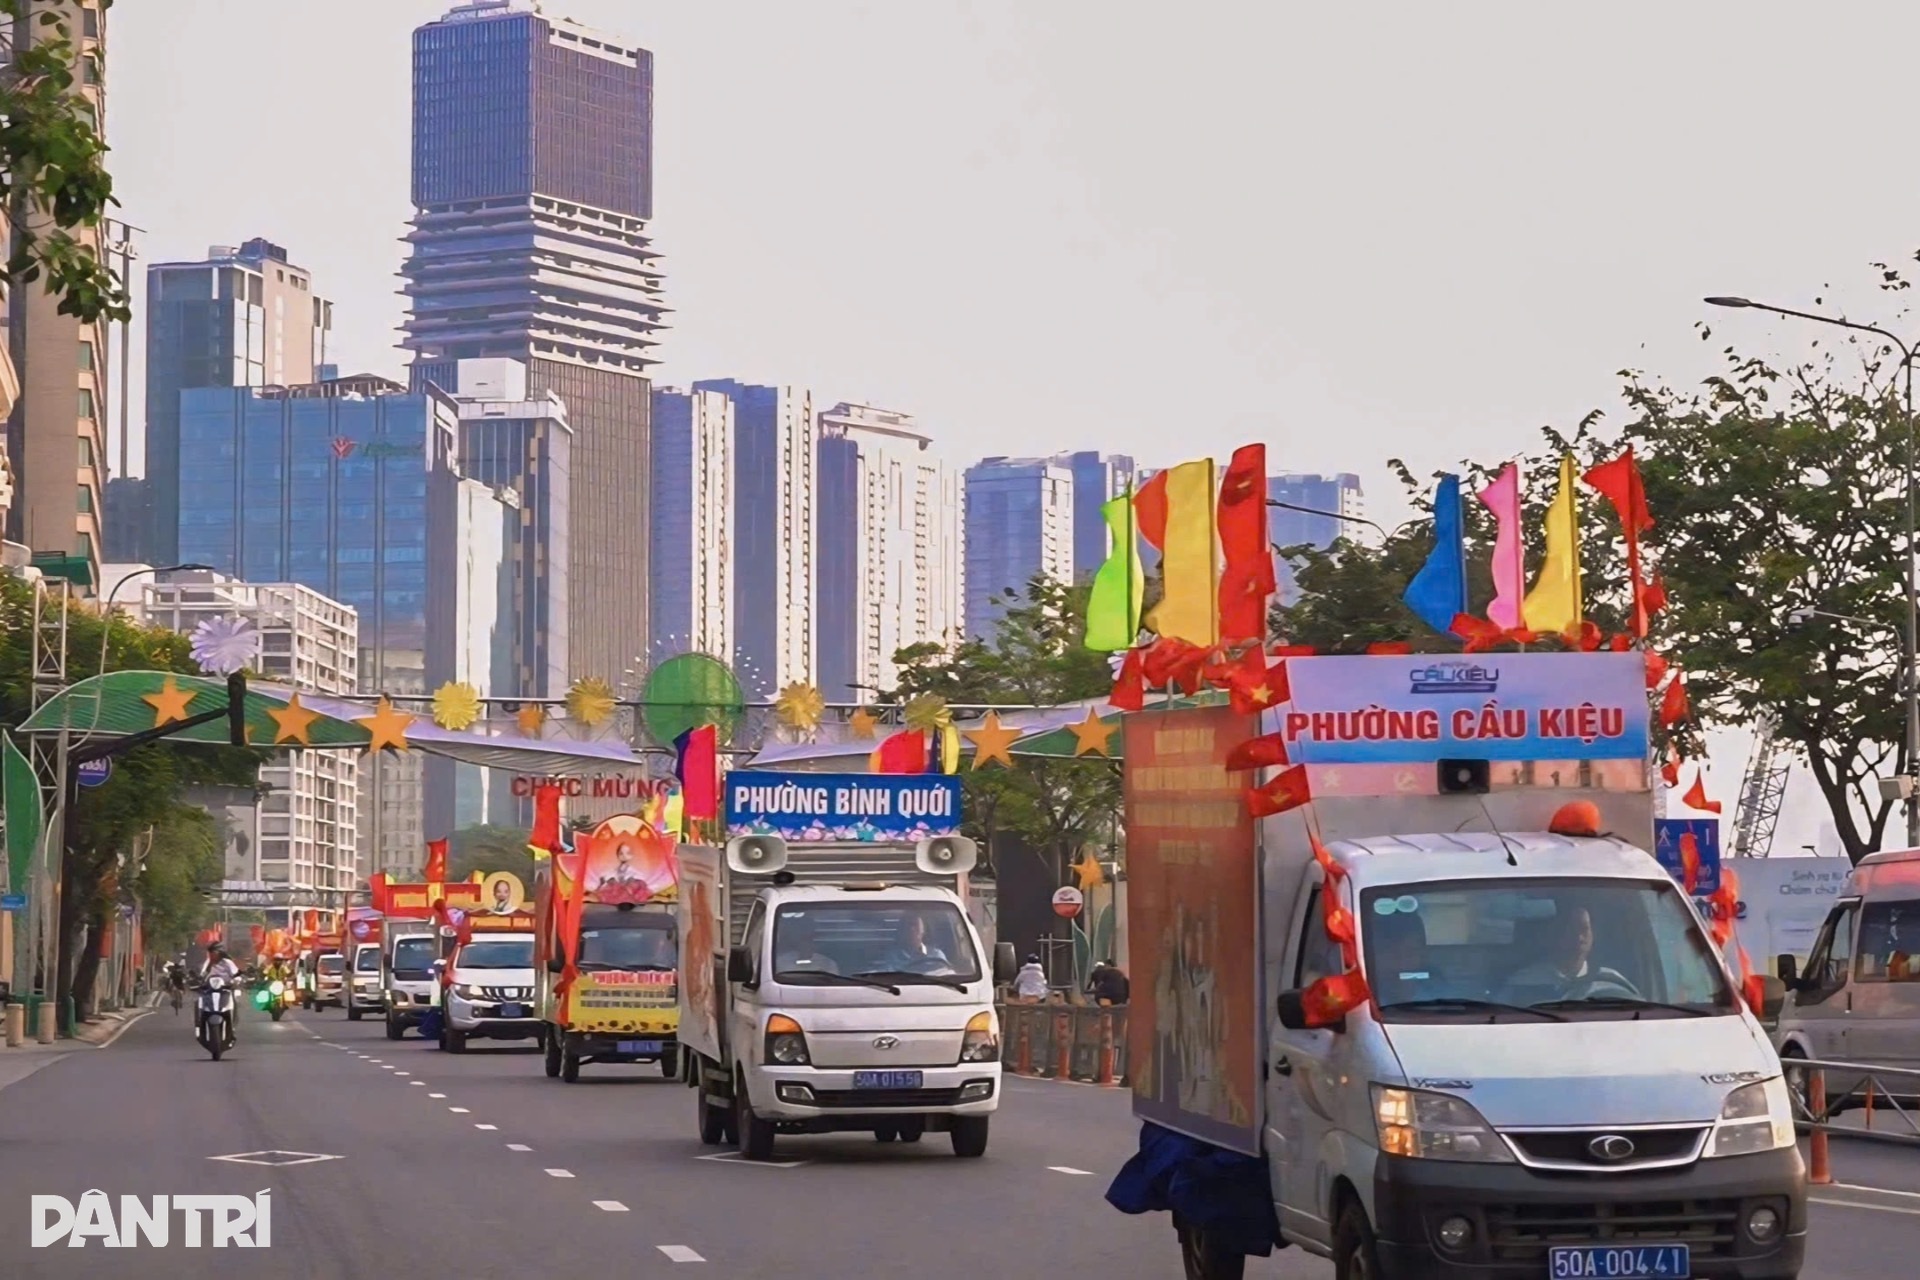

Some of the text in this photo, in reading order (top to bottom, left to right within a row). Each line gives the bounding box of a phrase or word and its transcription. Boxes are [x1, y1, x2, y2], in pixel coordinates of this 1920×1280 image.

[1286, 699, 1624, 744] PHƯỜNG CẦU KIỆU
[734, 780, 952, 818] PHƯỜNG BÌNH QUỚI
